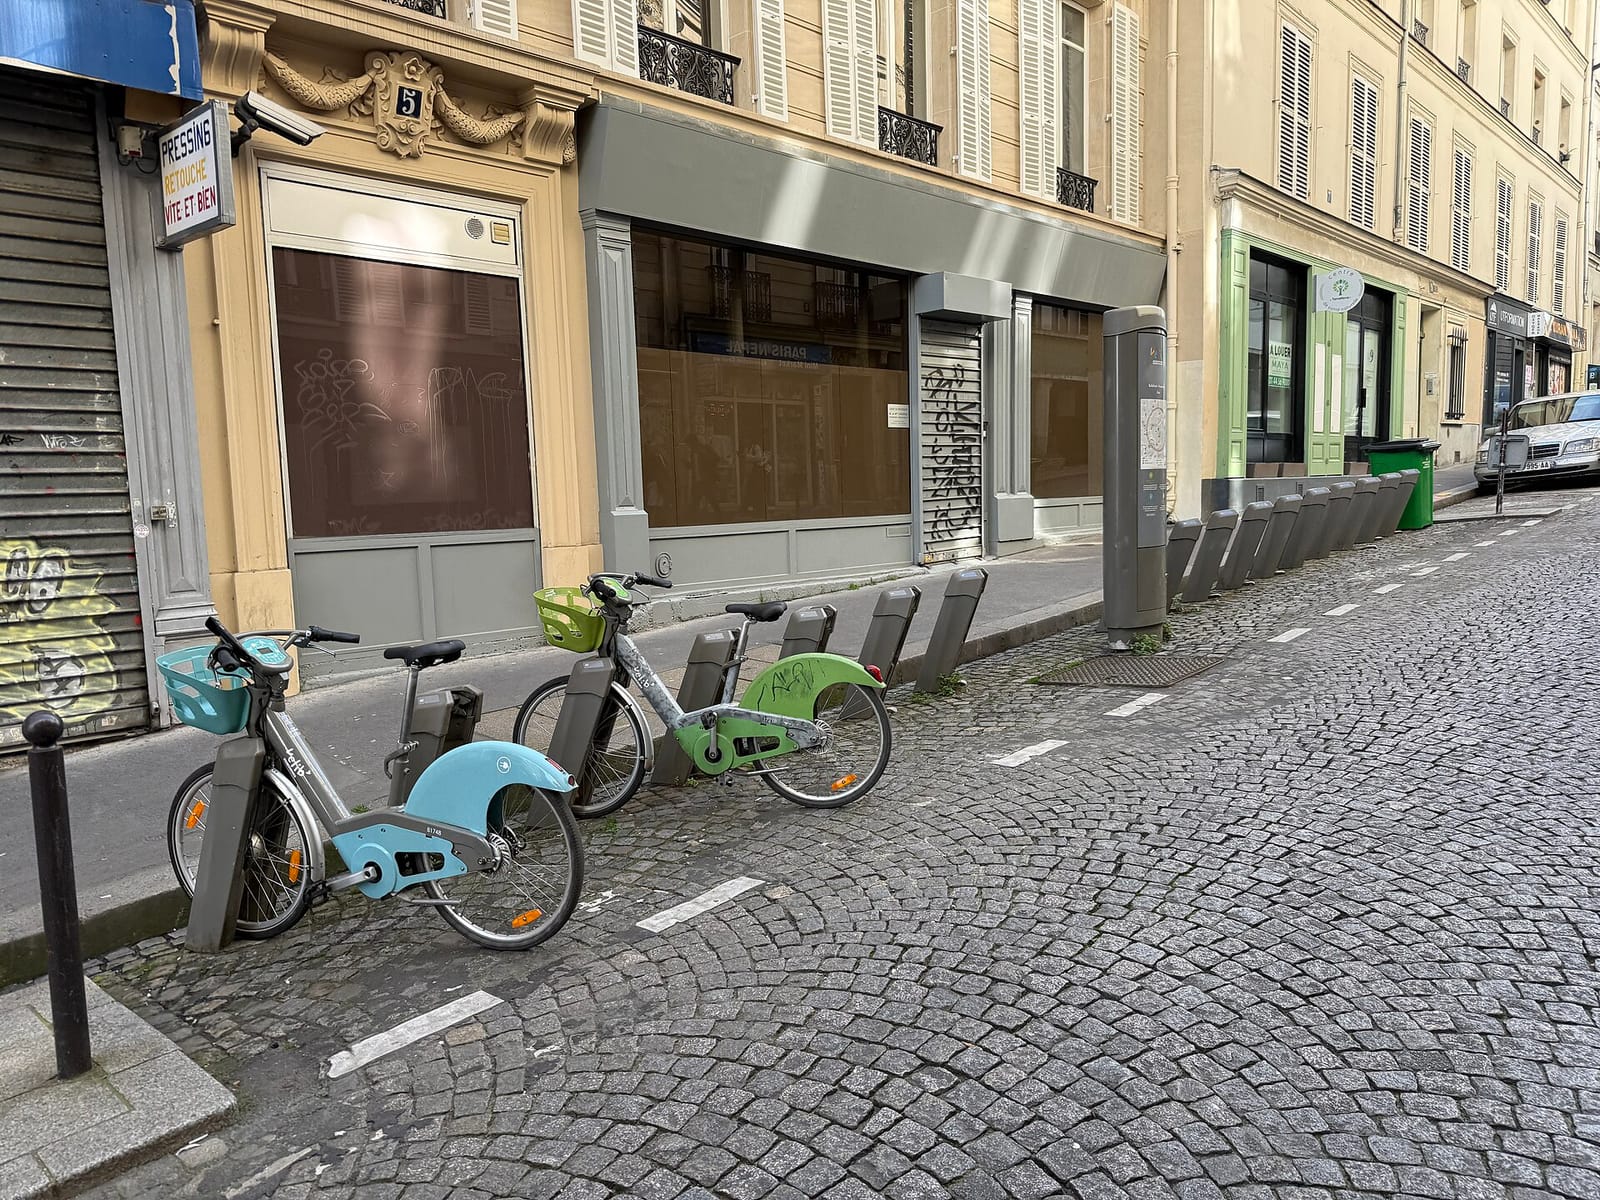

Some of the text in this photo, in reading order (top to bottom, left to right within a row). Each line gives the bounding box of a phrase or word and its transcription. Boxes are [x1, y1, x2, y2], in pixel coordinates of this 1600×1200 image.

[402, 89, 416, 115] 5
[162, 118, 211, 168] PRESSING
[164, 157, 208, 196] RETOUCHE
[1274, 344, 1291, 358] LOUER
